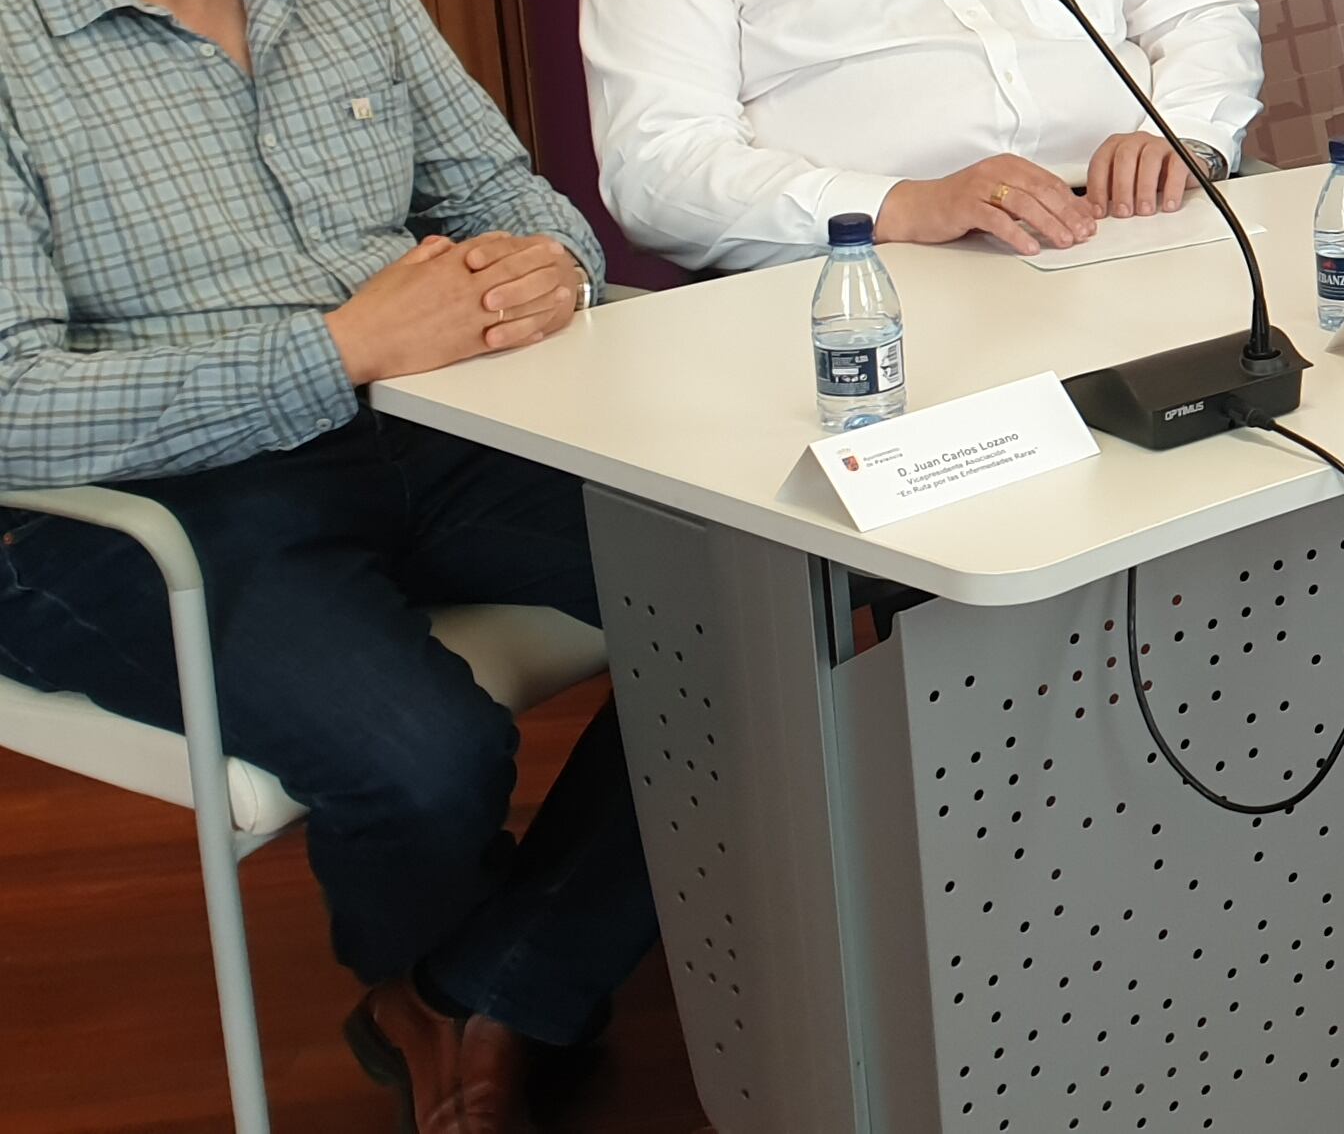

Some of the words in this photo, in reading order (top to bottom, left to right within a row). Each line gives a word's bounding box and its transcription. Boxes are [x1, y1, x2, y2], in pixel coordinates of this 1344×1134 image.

[1164, 401, 1204, 422] OPTIMUS
[897, 467, 912, 478] D.
[913, 458, 941, 473] Juan
[941, 447, 978, 463] Carlos
[978, 433, 1019, 451] Lozano
[906, 462, 964, 485] Vicepresidente
